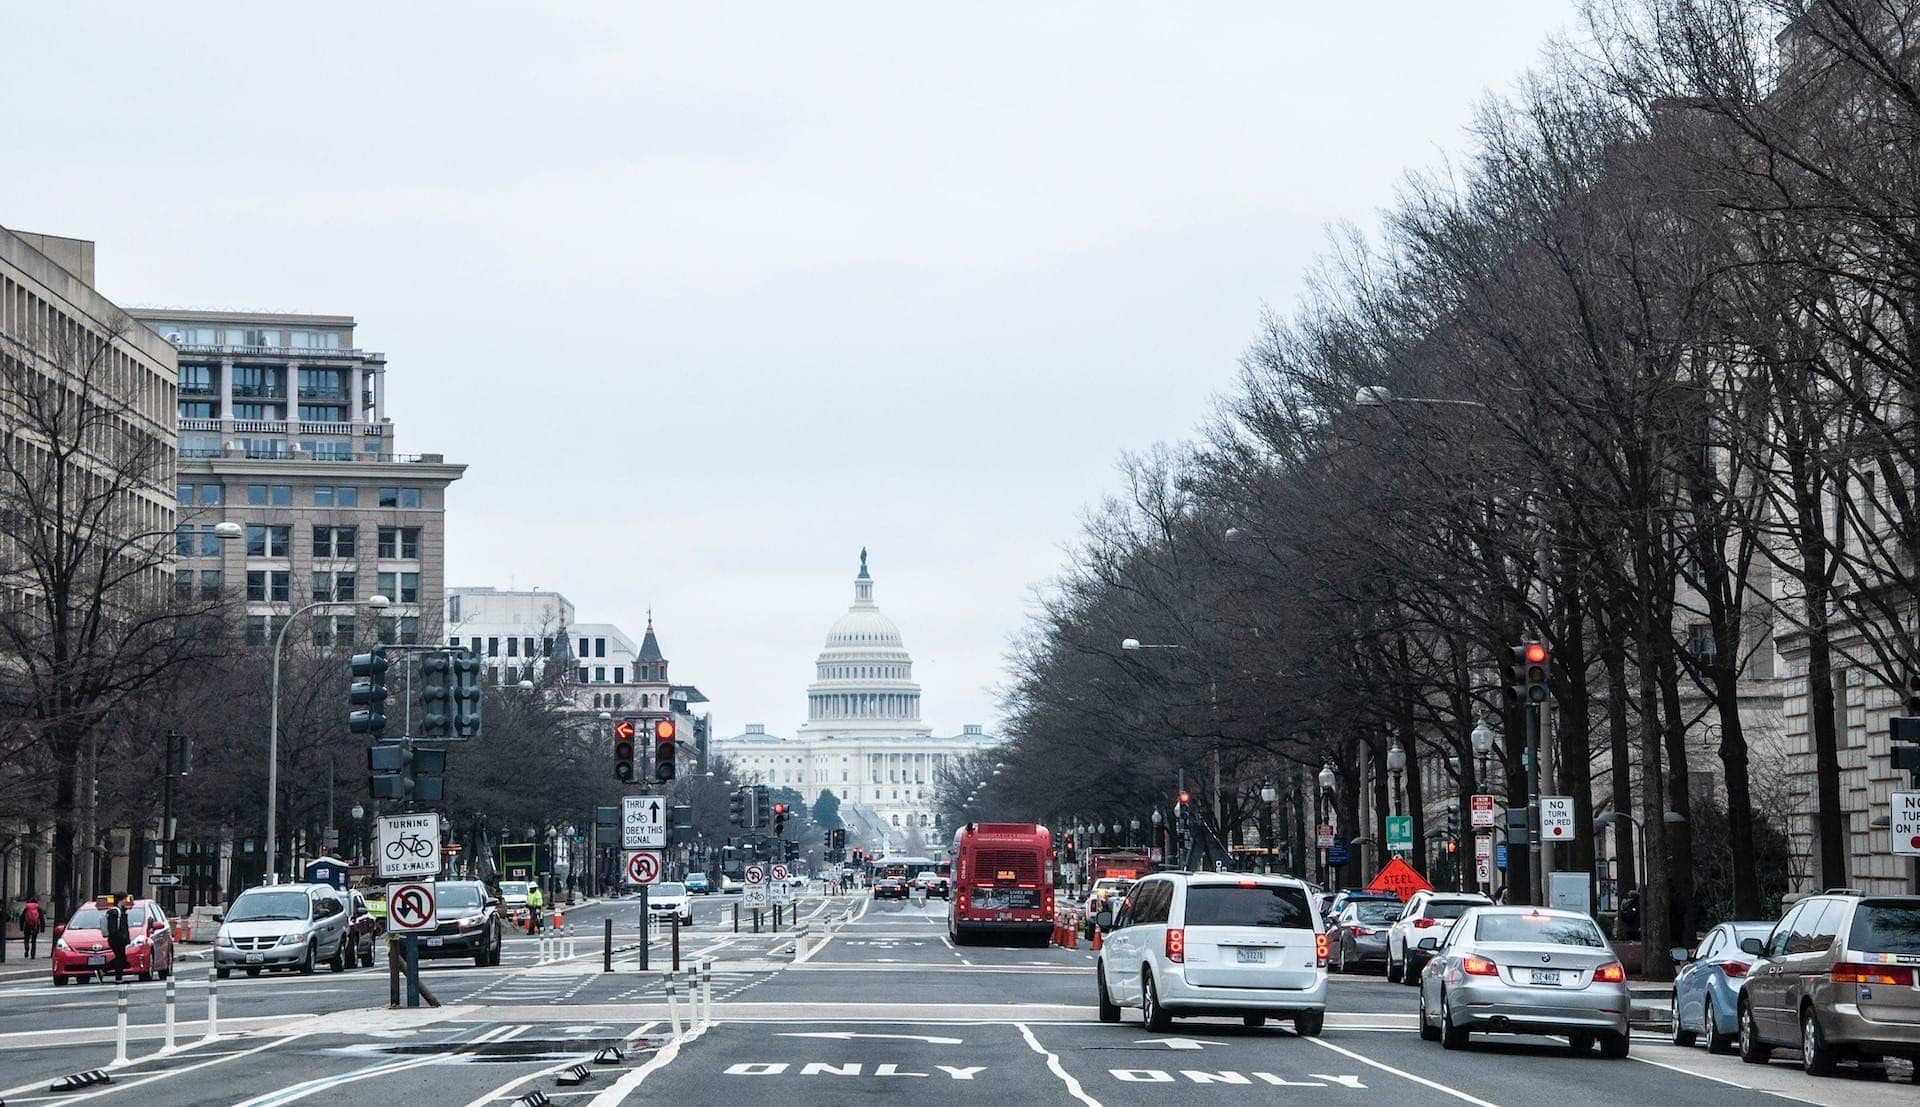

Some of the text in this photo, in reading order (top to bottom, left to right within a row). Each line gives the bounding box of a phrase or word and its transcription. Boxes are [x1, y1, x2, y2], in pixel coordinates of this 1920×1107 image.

[626, 800, 645, 809] THRU
[1550, 801, 1564, 809] NO
[388, 820, 429, 829] TURNING
[1896, 824, 1911, 833] ON
[625, 825, 663, 835] OBEY THIS
[625, 836, 651, 845] SIGNAL
[386, 864, 400, 872] USE
[1384, 875, 1413, 884] STEEL
[723, 1063, 989, 1080] ONLY
[1108, 1069, 1369, 1089] ONLY
